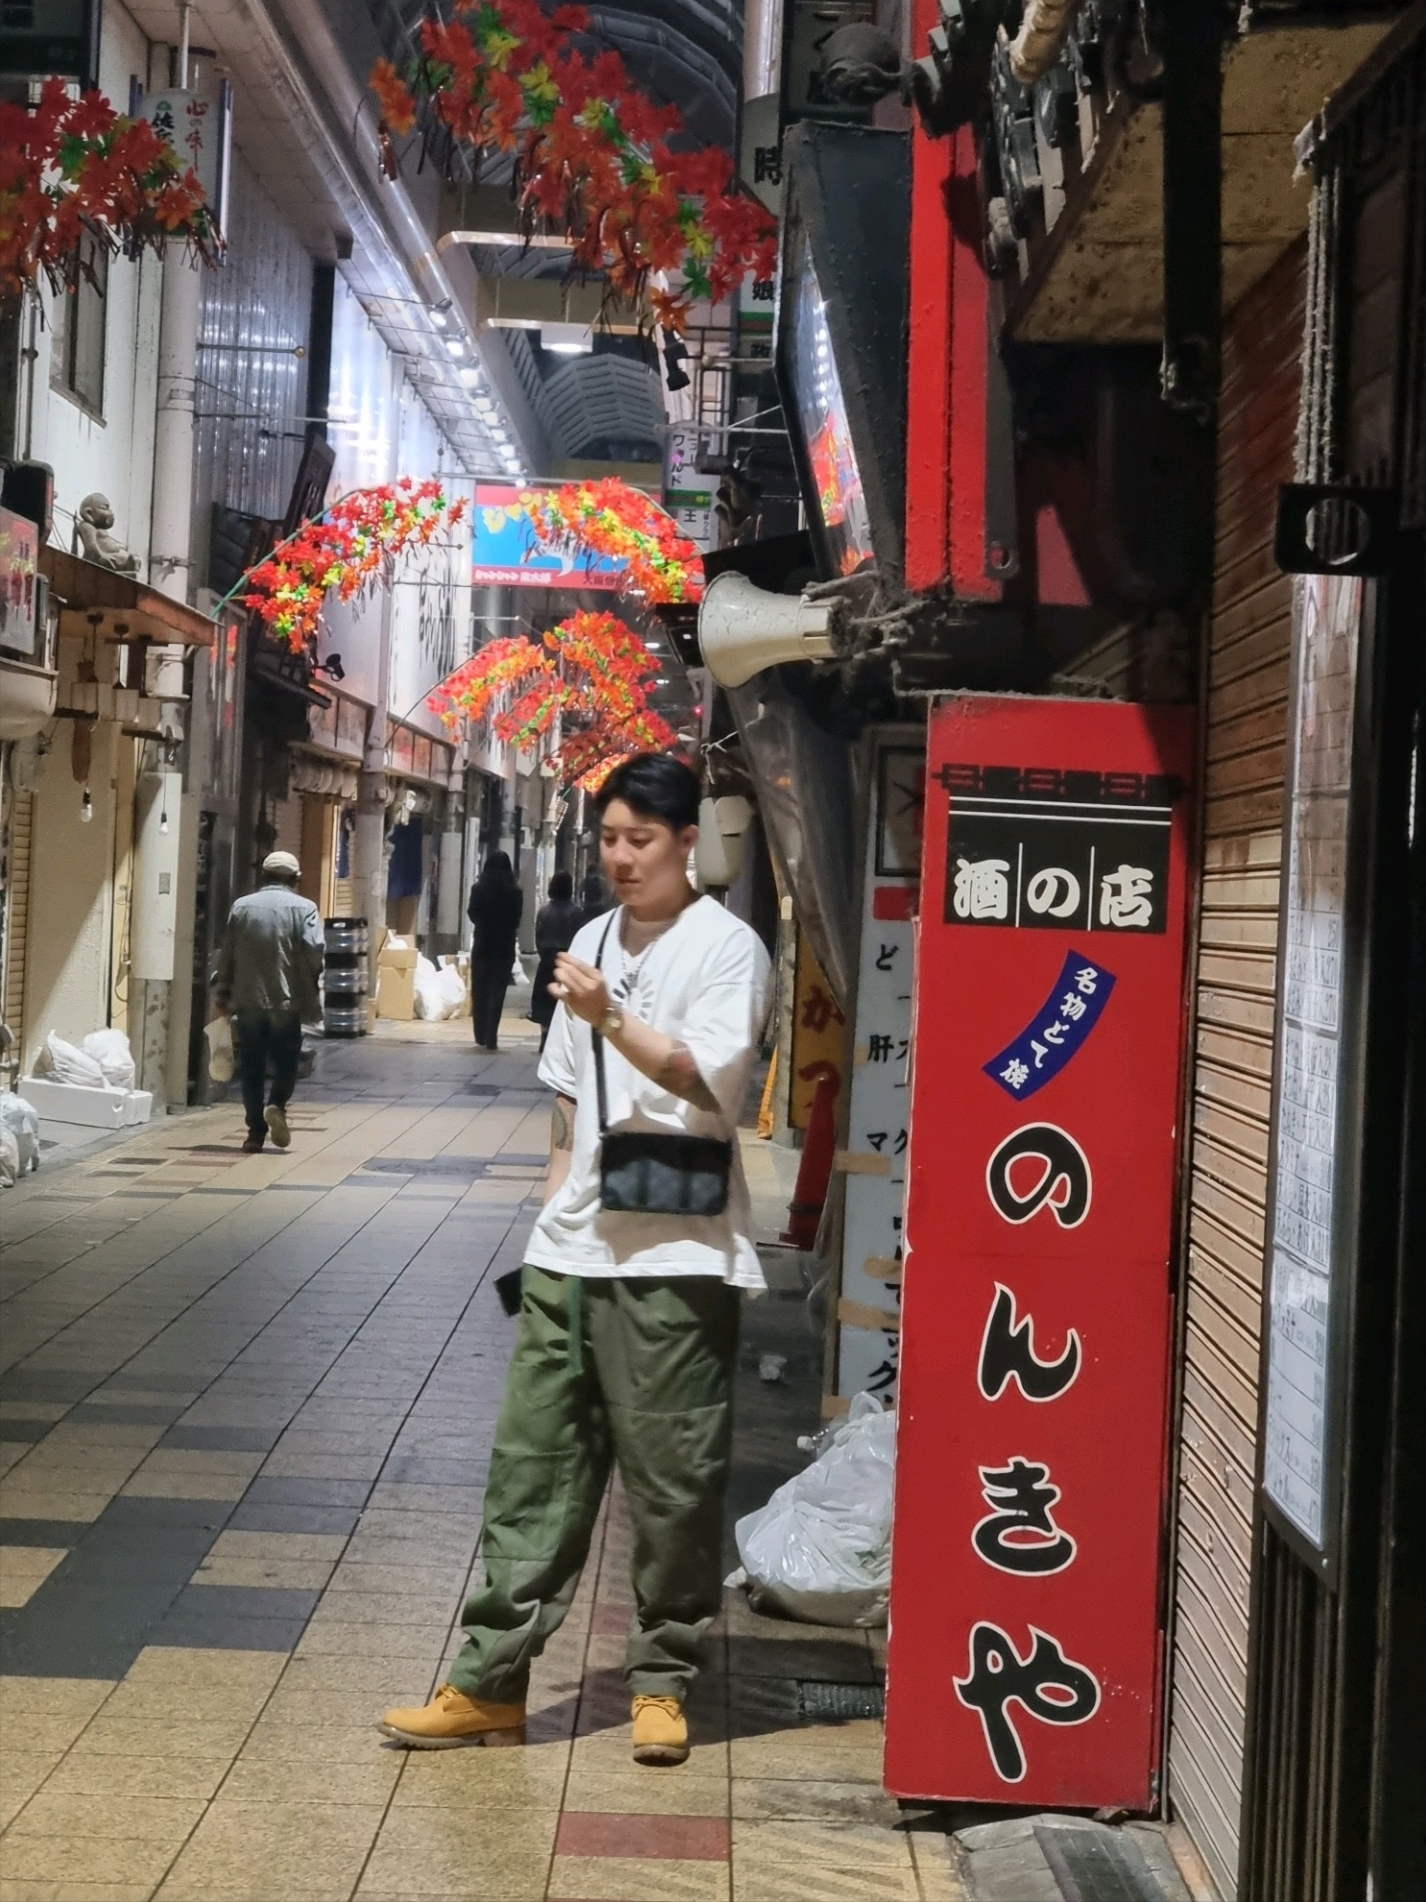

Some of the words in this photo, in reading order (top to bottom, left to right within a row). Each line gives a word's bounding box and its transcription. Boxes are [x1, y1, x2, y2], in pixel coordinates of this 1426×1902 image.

[953, 858, 1154, 927] 酒の店
[999, 967, 1098, 1090] 名物どて焼
[953, 1121, 1101, 1784] のんきや
